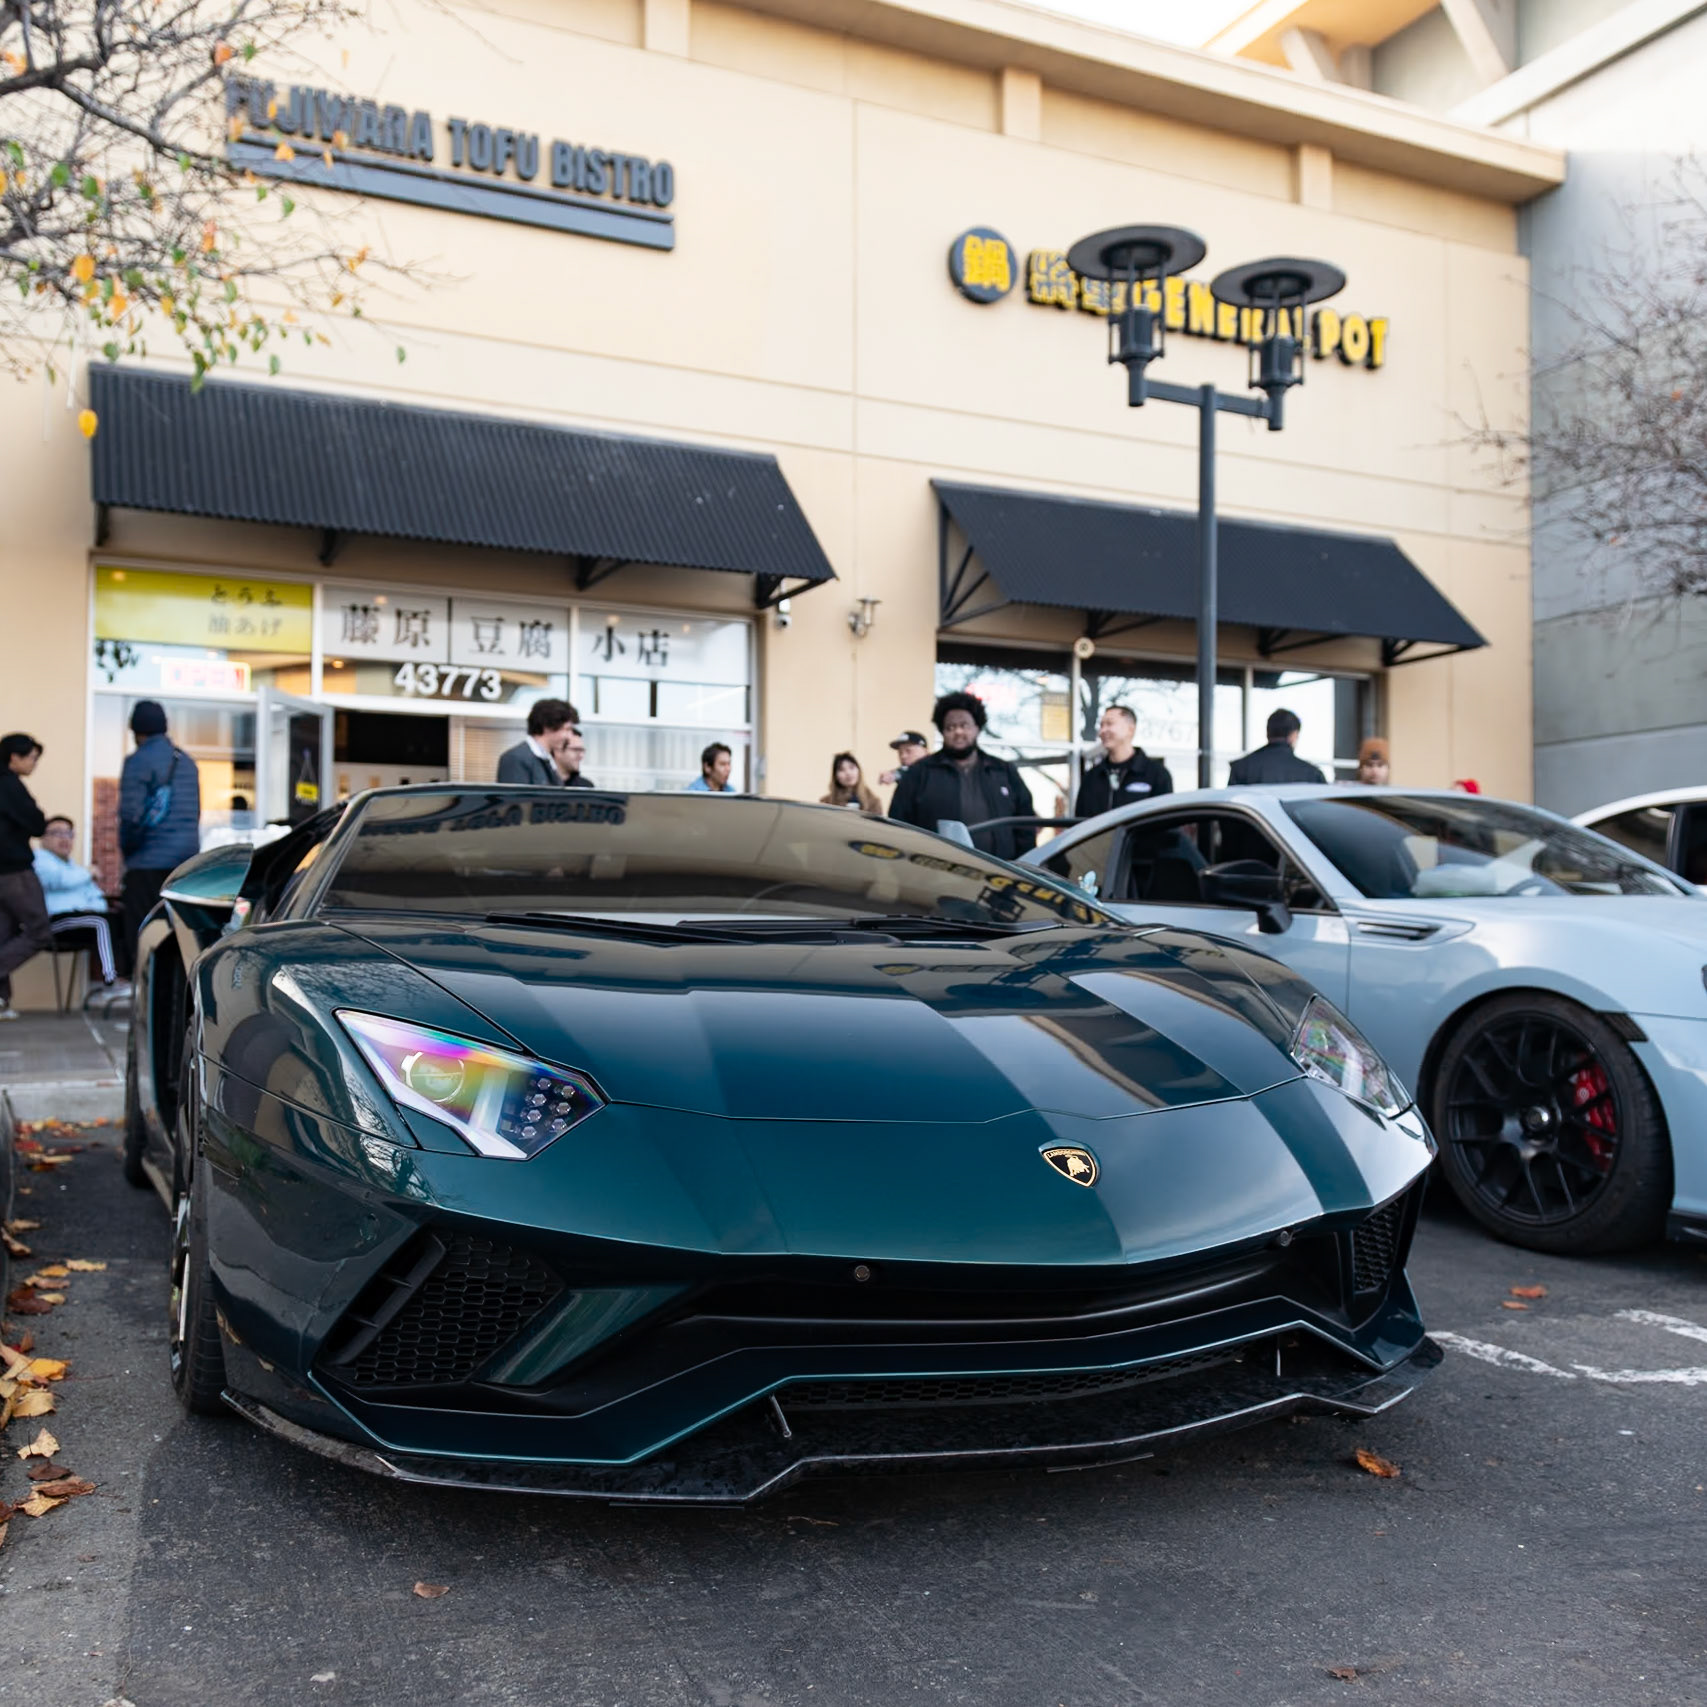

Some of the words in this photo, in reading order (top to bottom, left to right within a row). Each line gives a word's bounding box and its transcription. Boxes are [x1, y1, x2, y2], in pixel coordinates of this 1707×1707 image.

[226, 75, 434, 161] FUJIWARA
[449, 117, 539, 181] TOFU
[552, 140, 674, 207] BISTRO
[1315, 308, 1389, 368] POT
[394, 662, 502, 701] 43773
